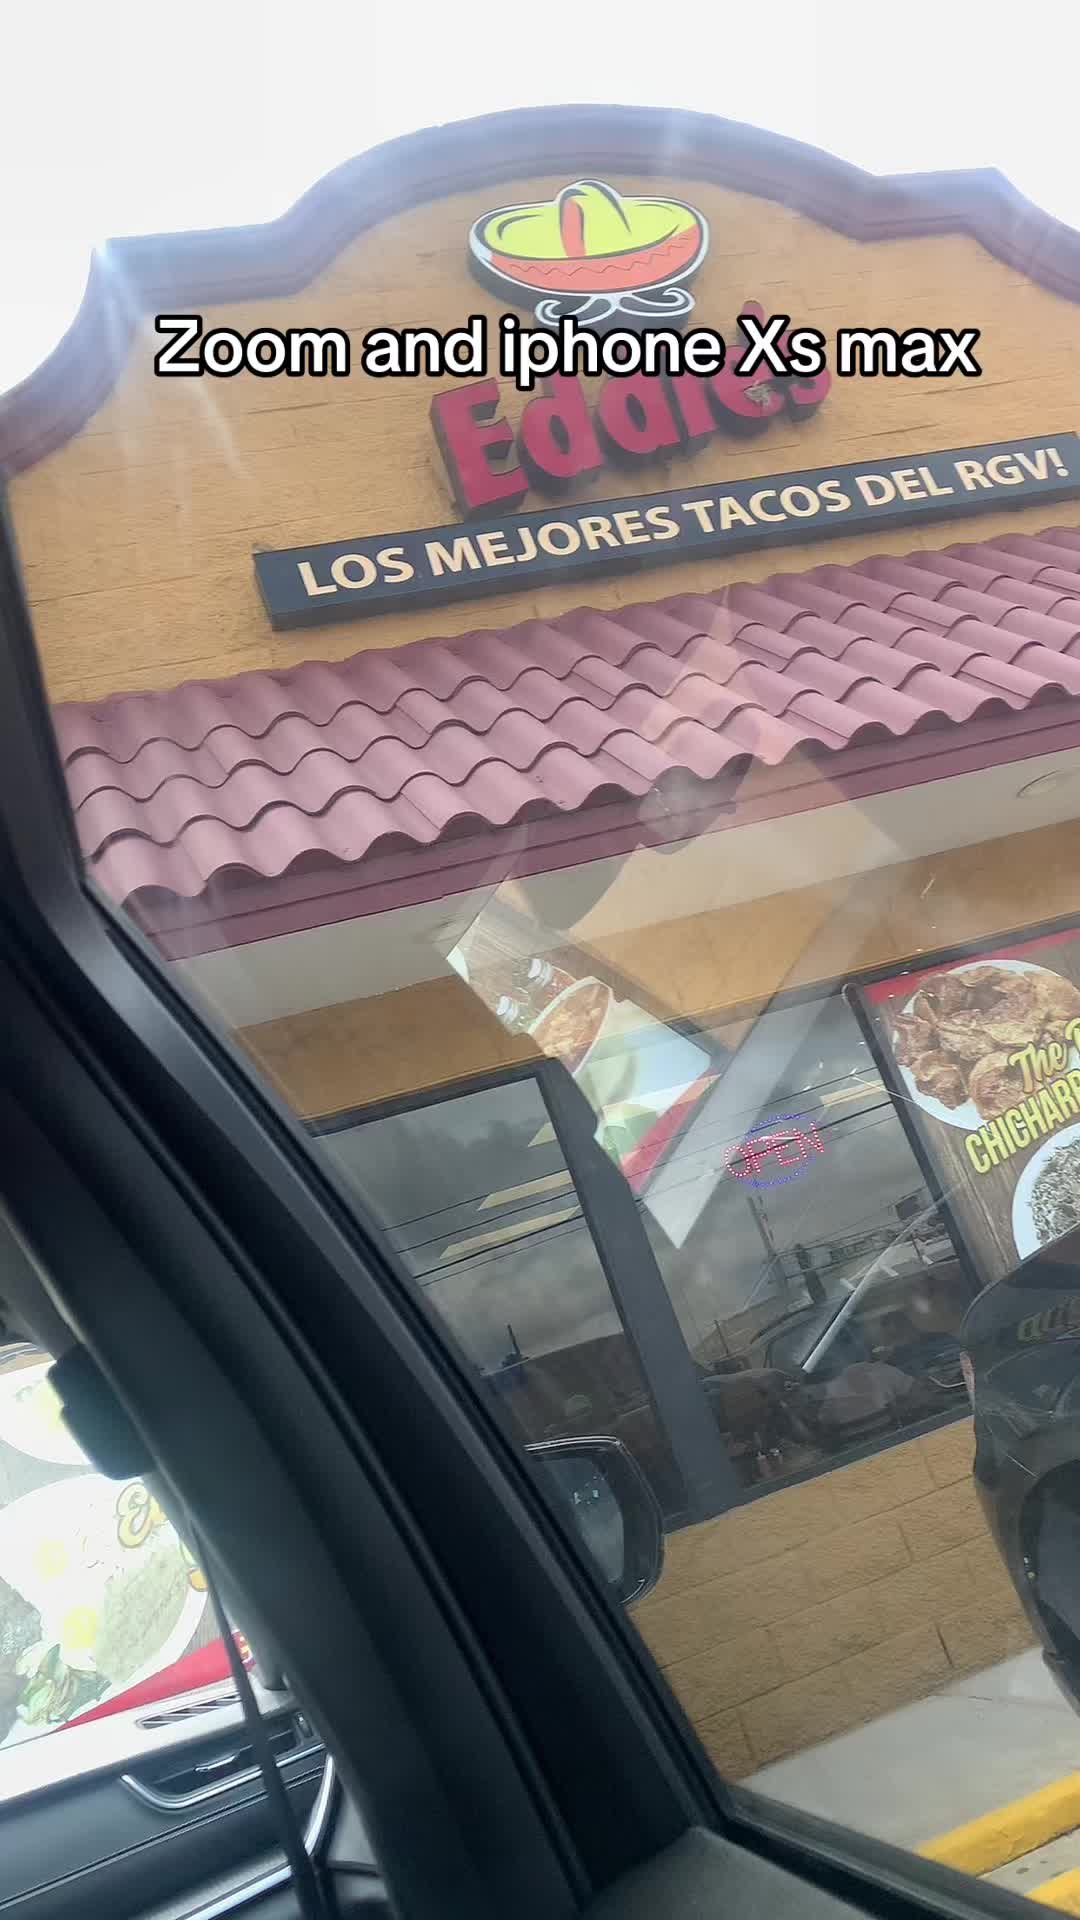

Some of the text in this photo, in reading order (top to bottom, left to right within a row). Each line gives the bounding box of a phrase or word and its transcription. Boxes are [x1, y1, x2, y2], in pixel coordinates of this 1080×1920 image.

[297, 447, 1070, 597] LOS MEJORES TACOS DEL RGV!
[1008, 1041, 1069, 1094] The
[724, 1122, 825, 1177] OPEN
